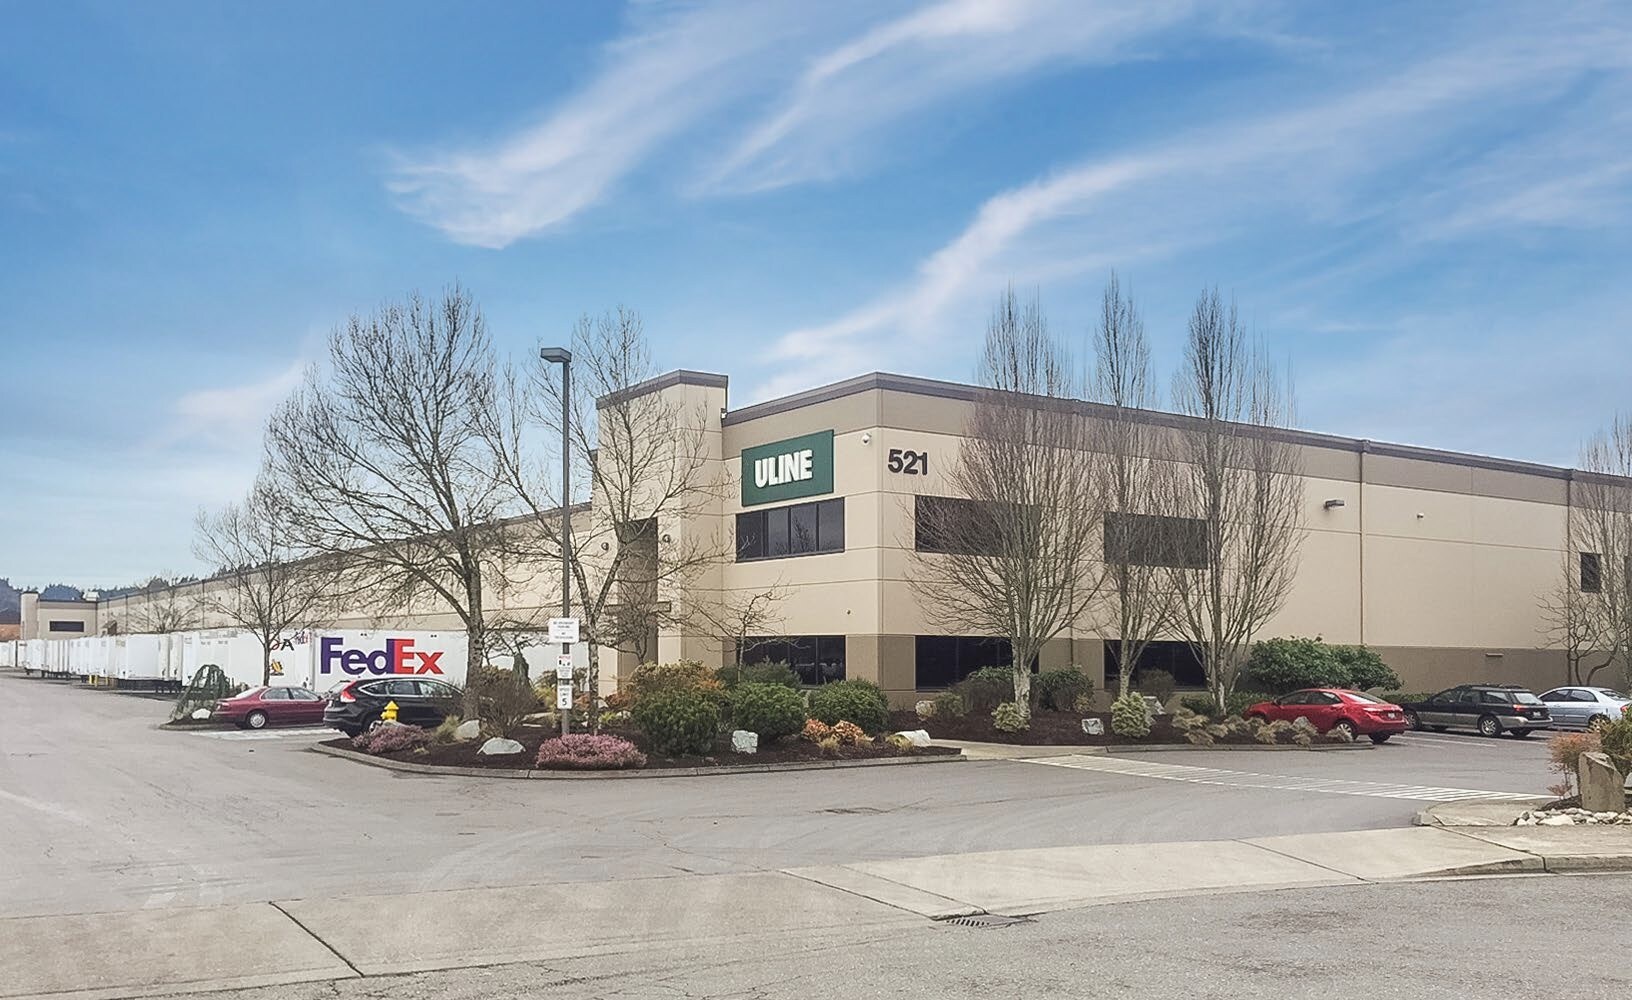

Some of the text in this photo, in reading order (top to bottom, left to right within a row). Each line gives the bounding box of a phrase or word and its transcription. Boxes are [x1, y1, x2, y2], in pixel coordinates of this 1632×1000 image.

[754, 449, 813, 488] ULINE
[887, 449, 928, 476] 521
[320, 636, 445, 676] FedEx
[562, 698, 568, 706] 5
